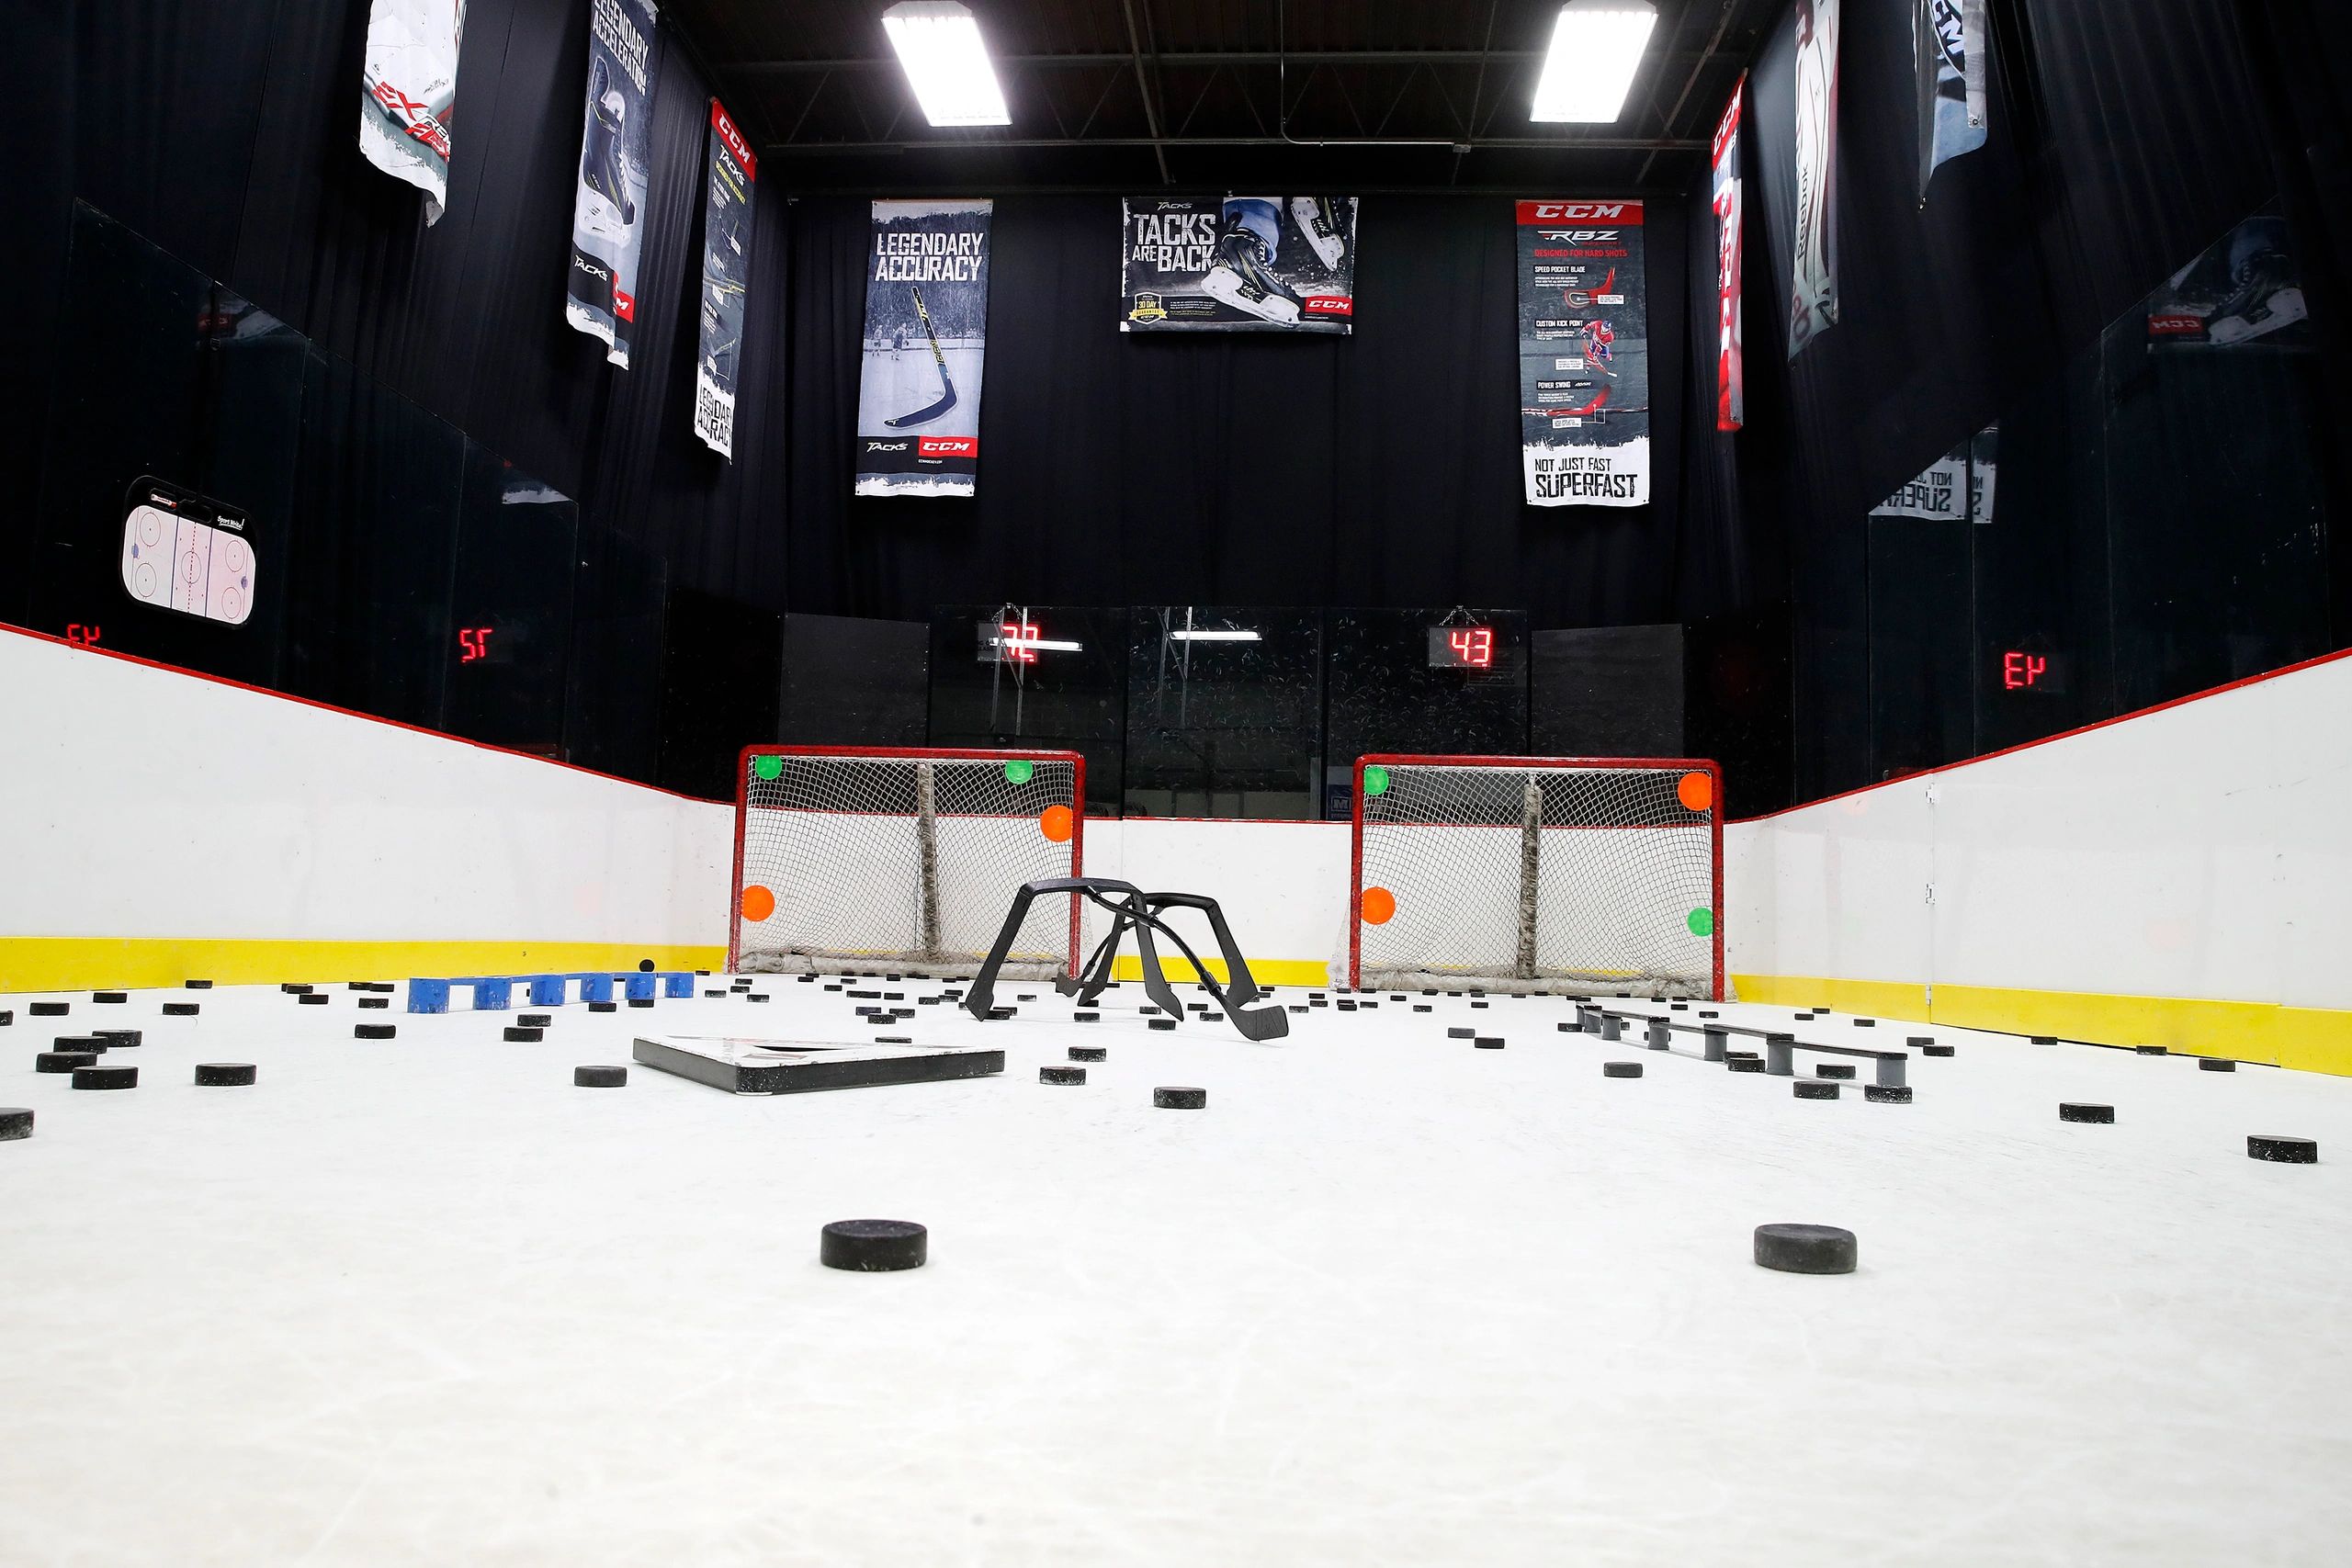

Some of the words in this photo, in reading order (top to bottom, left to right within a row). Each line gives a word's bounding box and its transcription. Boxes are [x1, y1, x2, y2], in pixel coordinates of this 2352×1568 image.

[718, 112, 751, 164] CCM
[719, 144, 745, 186] TACKS
[1157, 201, 1193, 210] TACKS
[1535, 205, 1623, 218] CCM
[1796, 162, 1809, 261] Reebok
[1133, 214, 1216, 245] TACKS
[1537, 230, 1619, 246] RBZ
[876, 233, 984, 255] LEGENDARY
[1534, 249, 1568, 257] DESIGNED
[1570, 249, 1584, 257] FOR
[1585, 249, 1604, 257] HARD
[1605, 249, 1627, 257] SHOTS
[573, 254, 608, 282] TACKS
[875, 255, 983, 282] ACCURACY
[1132, 245, 1157, 262] ARE
[1158, 244, 1216, 272] BACK
[1138, 300, 1146, 309] 30
[1308, 300, 1350, 310] CCM
[866, 442, 909, 453] TACKS
[922, 442, 970, 451] CCM
[1535, 458, 1555, 471] NOT
[1558, 457, 1585, 470] JUST
[1589, 457, 1611, 471] FAST
[1535, 472, 1638, 498] SUPERFAST
[1452, 630, 1491, 662] 43
